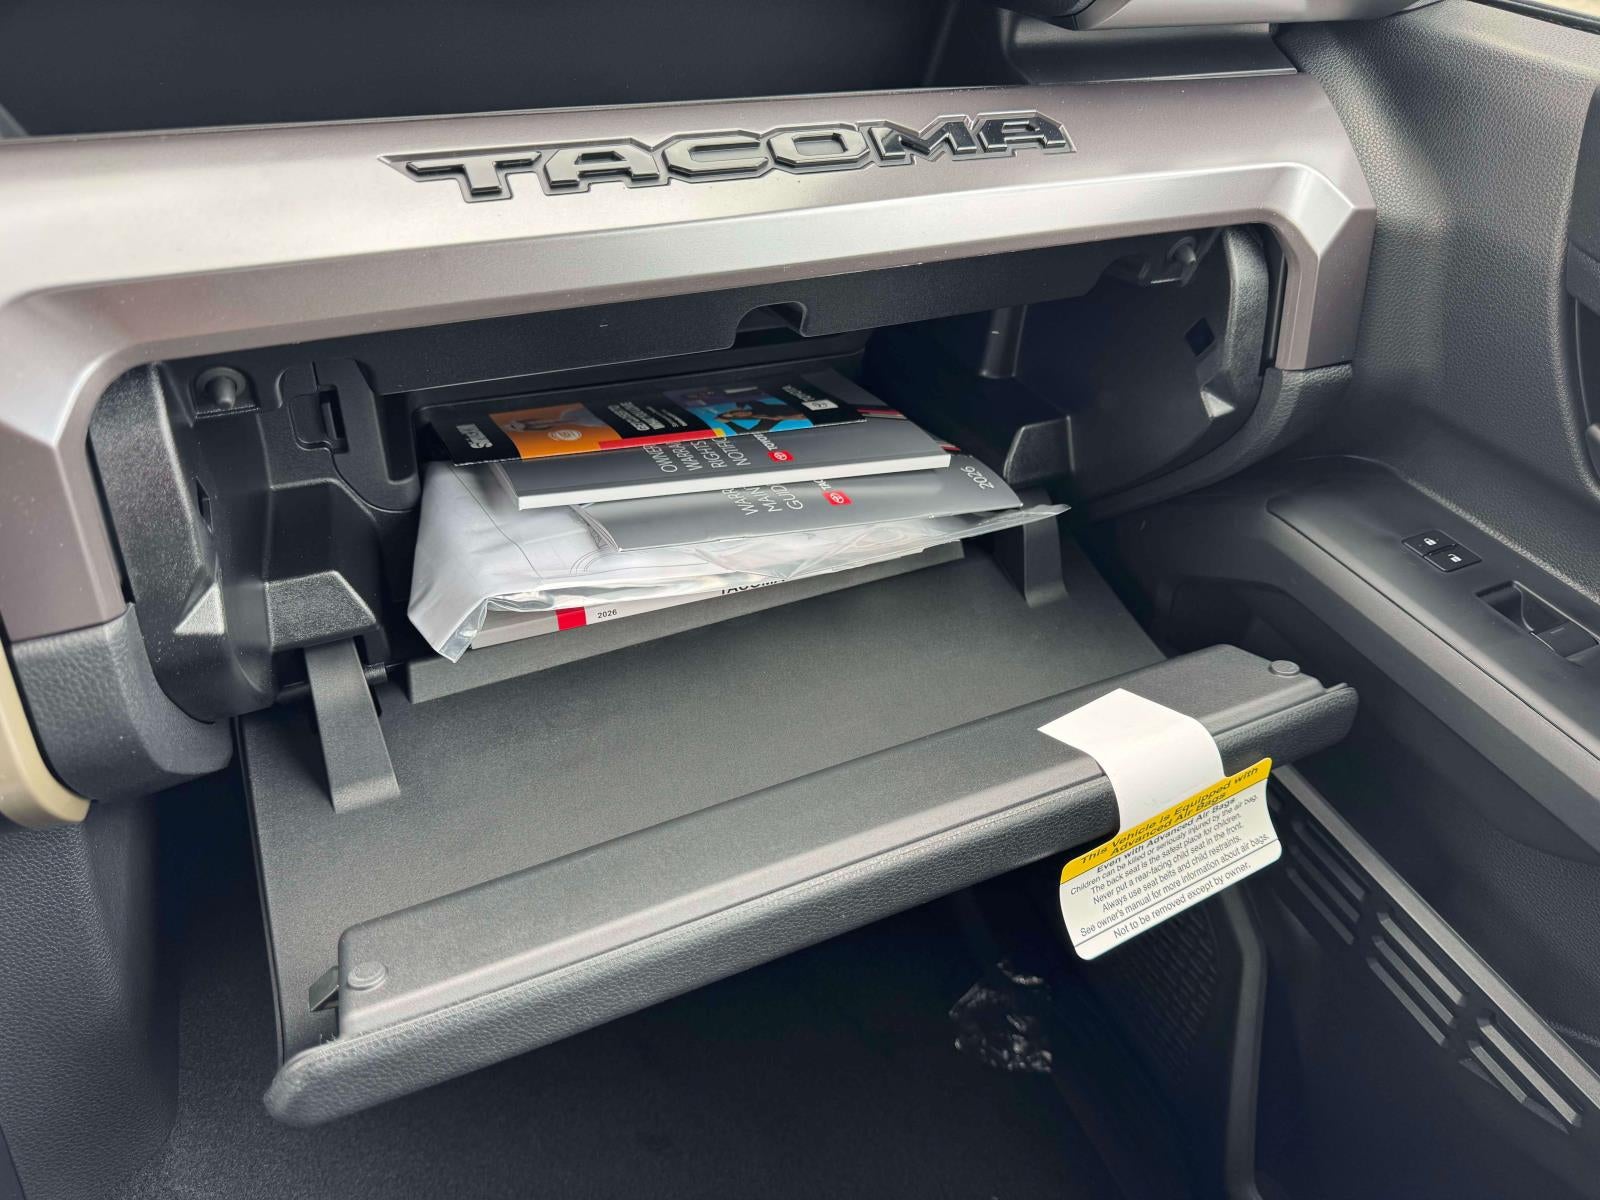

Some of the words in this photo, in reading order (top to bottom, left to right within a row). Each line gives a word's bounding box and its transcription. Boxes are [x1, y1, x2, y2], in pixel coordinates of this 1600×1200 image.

[402, 113, 1070, 198] TACOMA
[667, 442, 703, 471] WARRA
[691, 440, 728, 469] RIGHTS
[960, 465, 995, 490] 2026
[745, 486, 783, 512] MAIN
[597, 608, 618, 619] 2026
[1070, 876, 1101, 896] Children
[1102, 868, 1116, 879] can
[1116, 861, 1127, 872] be
[1127, 851, 1146, 866] killed
[1156, 831, 1187, 850] seriously
[1188, 818, 1212, 835] injured
[1222, 807, 1233, 817] the
[1234, 801, 1244, 811] air
[1081, 847, 1108, 864] This
[1112, 822, 1156, 848] Vehicle
[1160, 814, 1171, 824] is
[1174, 780, 1231, 816] Equipped
[1234, 767, 1259, 784] with
[1097, 856, 1121, 873] Even
[1124, 846, 1144, 860] with
[1146, 818, 1194, 848] Advanced
[1196, 811, 1210, 823] Air
[1212, 797, 1236, 813] Bags
[1110, 819, 1172, 856] Advanced
[1176, 808, 1193, 822] Air
[1196, 792, 1226, 812] Bags
[1080, 924, 1096, 937] See
[1096, 909, 1125, 929] owner's
[1125, 894, 1152, 914] manual
[1152, 888, 1162, 900] for
[1162, 879, 1181, 895] more
[1182, 858, 1220, 885] information
[1221, 848, 1241, 864] about
[1241, 841, 1250, 854] air
[1250, 833, 1270, 849] bags.
[1091, 884, 1105, 895] The
[1106, 872, 1125, 887] back
[1124, 864, 1141, 877] seat
[1149, 853, 1161, 865] the
[1162, 842, 1184, 859] safest
[1183, 832, 1203, 848] place
[1203, 826, 1213, 836] for
[1093, 889, 1114, 905] Never
[1115, 881, 1128, 896] put
[1135, 859, 1173, 883] rear-facing
[1173, 849, 1189, 863] child
[1190, 840, 1206, 854] seat
[1214, 829, 1226, 841] the
[1102, 893, 1128, 913] Always
[1128, 887, 1142, 899] use
[1143, 879, 1159, 892] seat
[1159, 866, 1177, 881] belts
[1177, 862, 1192, 876] and
[1192, 851, 1208, 867] child
[1209, 834, 1242, 856] restraints.
[1114, 924, 1130, 939] Not
[1130, 919, 1140, 931] to
[1139, 912, 1151, 925] be
[1151, 893, 1186, 920] removed
[1187, 880, 1214, 901] except
[1214, 873, 1225, 886] by
[1225, 861, 1251, 880] owner.
